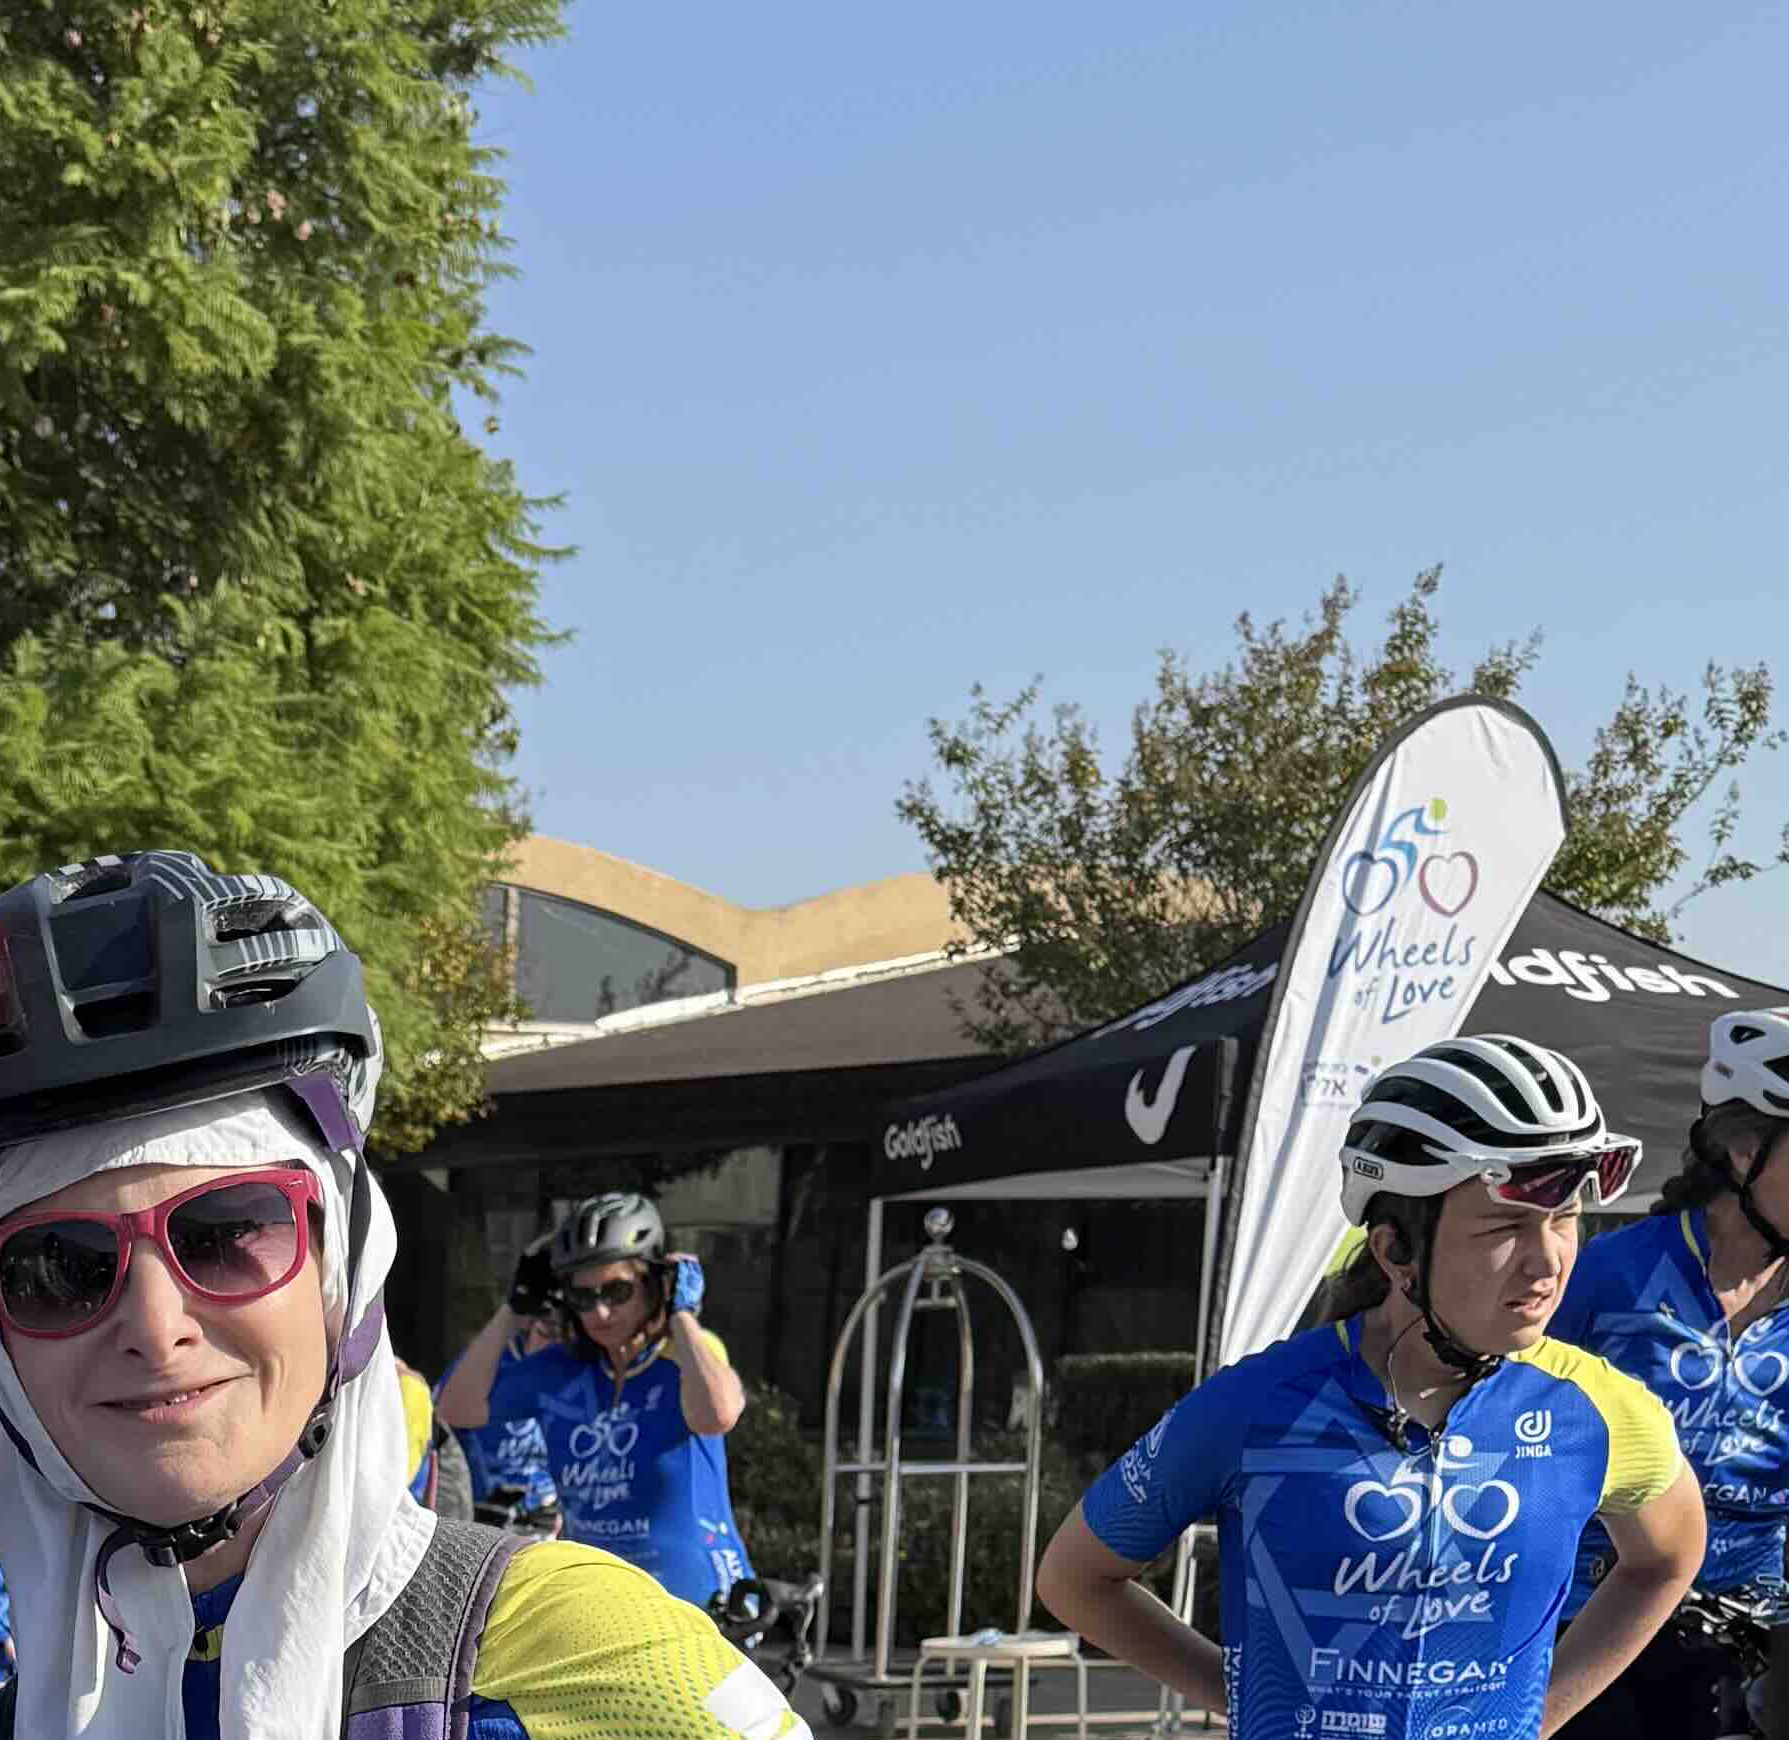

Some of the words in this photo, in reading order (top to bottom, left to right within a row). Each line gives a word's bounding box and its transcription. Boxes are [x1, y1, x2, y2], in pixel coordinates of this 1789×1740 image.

[1328, 916, 1476, 979] Wheels
[1353, 980, 1378, 1008] of
[1381, 975, 1456, 1024] Love
[1489, 947, 1741, 1002] ldfish
[1334, 1533, 1519, 1597] Wheels
[1368, 1595, 1403, 1626] of
[1402, 1589, 1493, 1641] Love
[1310, 1647, 1509, 1685] FINNEGAN
[1430, 1719, 1509, 1738] ORAMED
